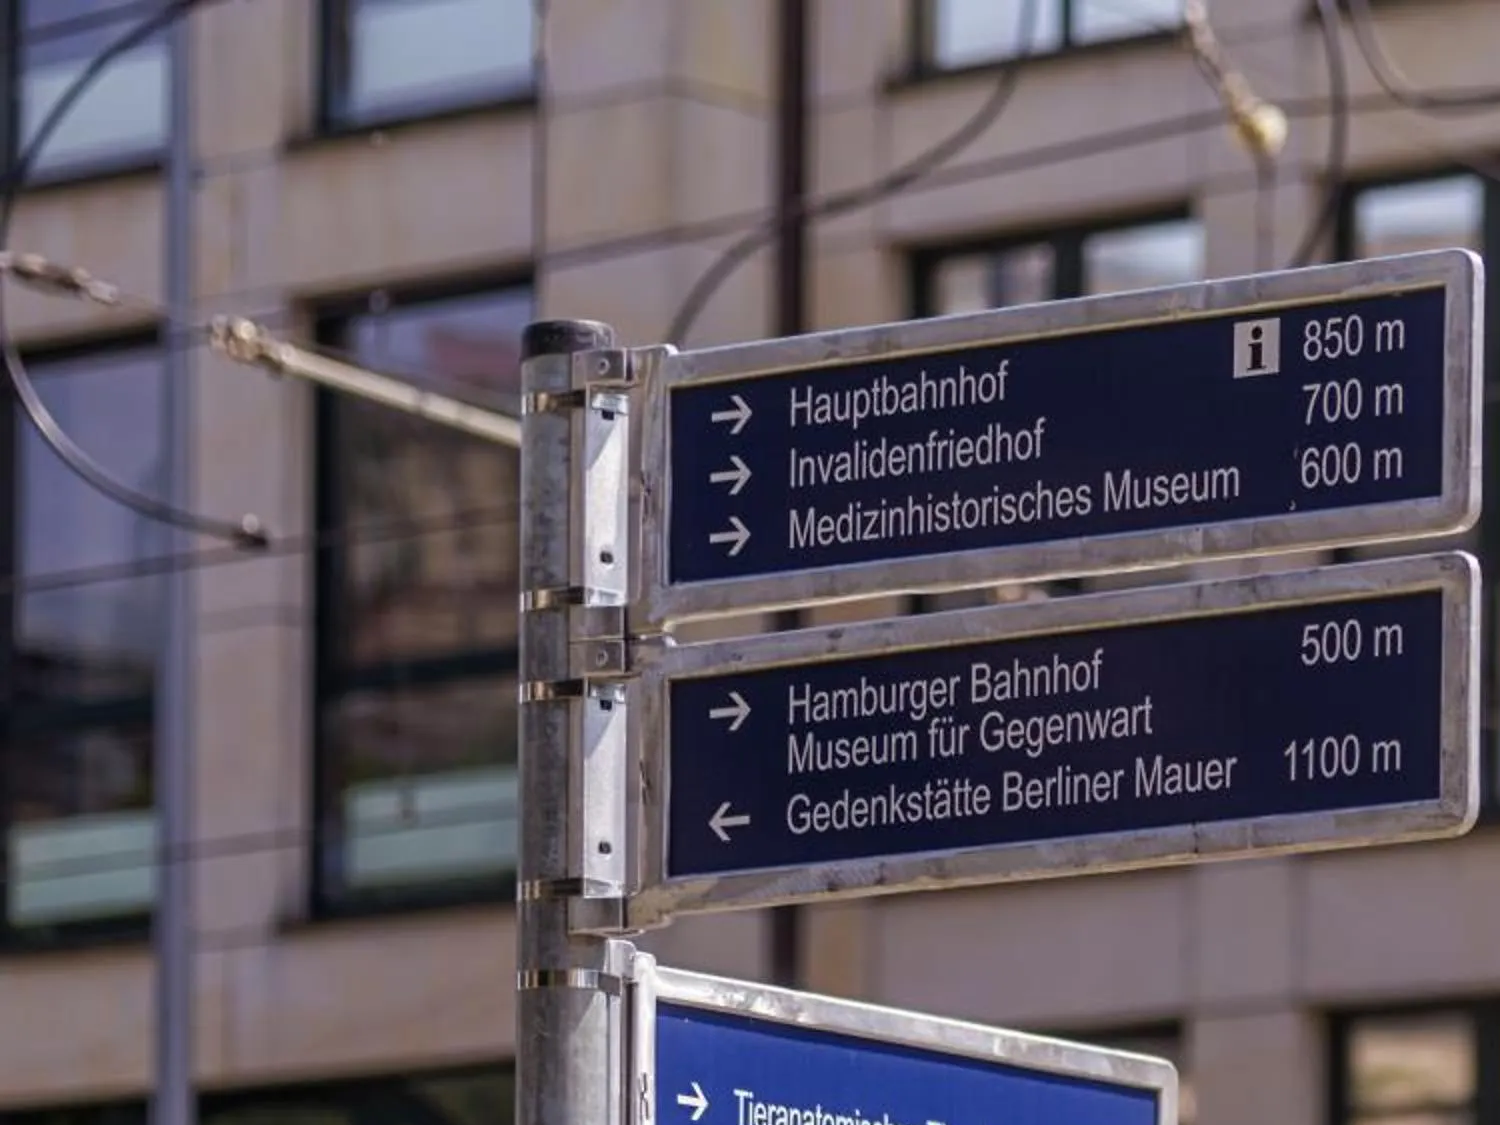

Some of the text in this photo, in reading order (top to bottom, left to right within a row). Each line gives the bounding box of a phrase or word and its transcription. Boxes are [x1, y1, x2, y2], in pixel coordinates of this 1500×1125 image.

[789, 359, 1010, 430] Hauptbahnhof
[1302, 314, 1364, 362] 850
[1375, 319, 1406, 353] m
[789, 378, 1404, 489] Invalidenfriedhof 700 m
[788, 442, 1403, 550] Medizinhistorisches Museum 600 m
[788, 618, 1404, 725] Hamburger Bahnhof 500 m
[786, 696, 1154, 775] Museum für Gegenwart
[786, 734, 1402, 835] Gedenkstätte Berliner Mauer 1100 m
